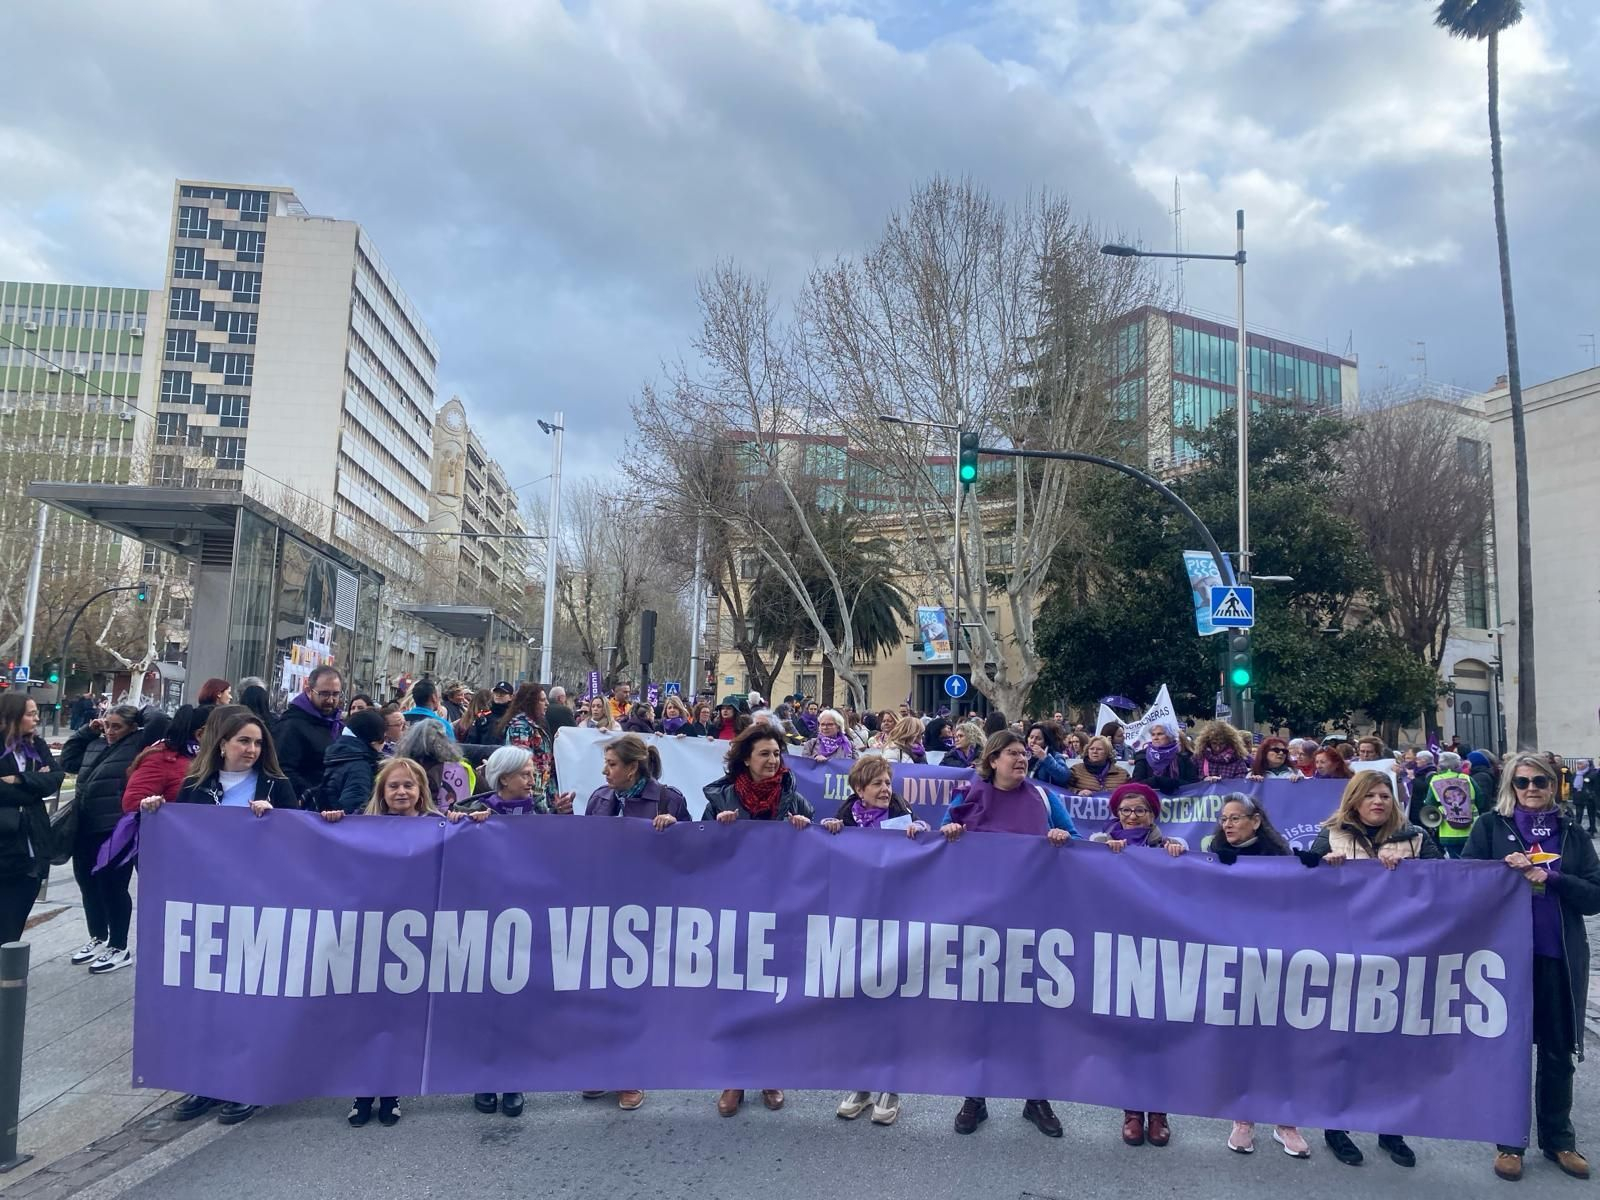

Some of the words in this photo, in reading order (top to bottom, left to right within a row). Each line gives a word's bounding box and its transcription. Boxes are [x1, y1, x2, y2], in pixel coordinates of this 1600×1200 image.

[1187, 560, 1218, 570] PICA
[443, 769, 463, 787] cio
[824, 773, 855, 800] LIB
[1160, 795, 1224, 823] SIEMP
[1531, 828, 1551, 836] CGT
[163, 901, 532, 997] FEMINISMO
[548, 905, 788, 1004] VISIBLE,
[805, 915, 1075, 1009] MUJERES
[1092, 931, 1508, 1038] INVENCIBLES
